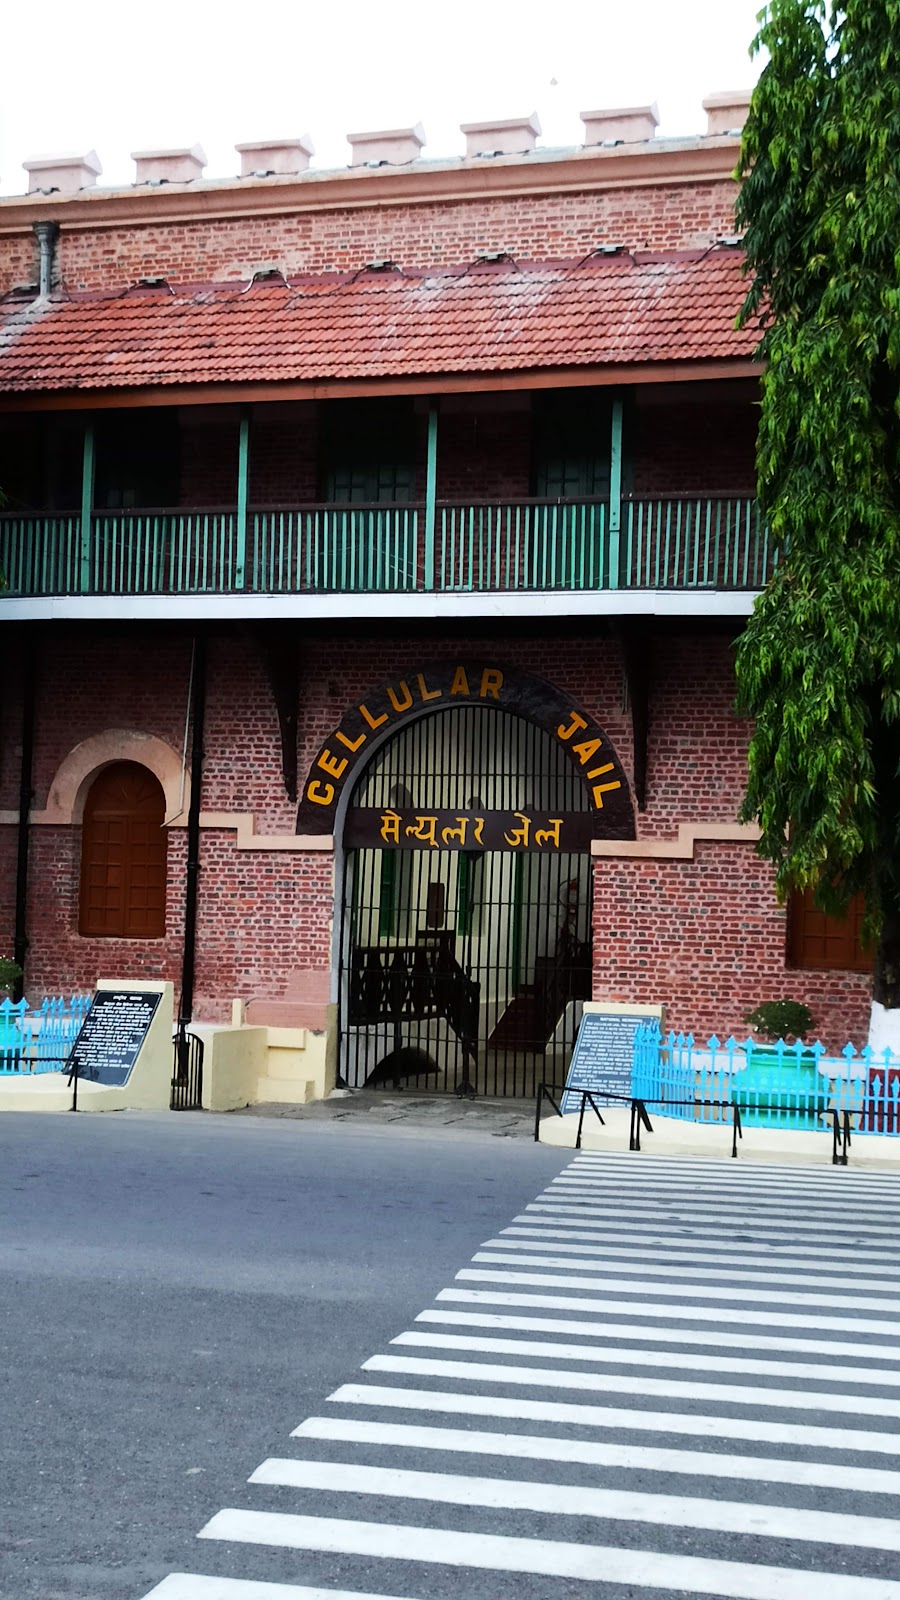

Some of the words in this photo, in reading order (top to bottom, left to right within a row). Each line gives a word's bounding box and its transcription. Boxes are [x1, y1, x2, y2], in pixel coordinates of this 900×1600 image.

[307, 666, 504, 806] CELLULAR
[557, 711, 622, 809] JAIL
[380, 809, 485, 848] सेल्यूलर
[503, 812, 564, 848] जेल
